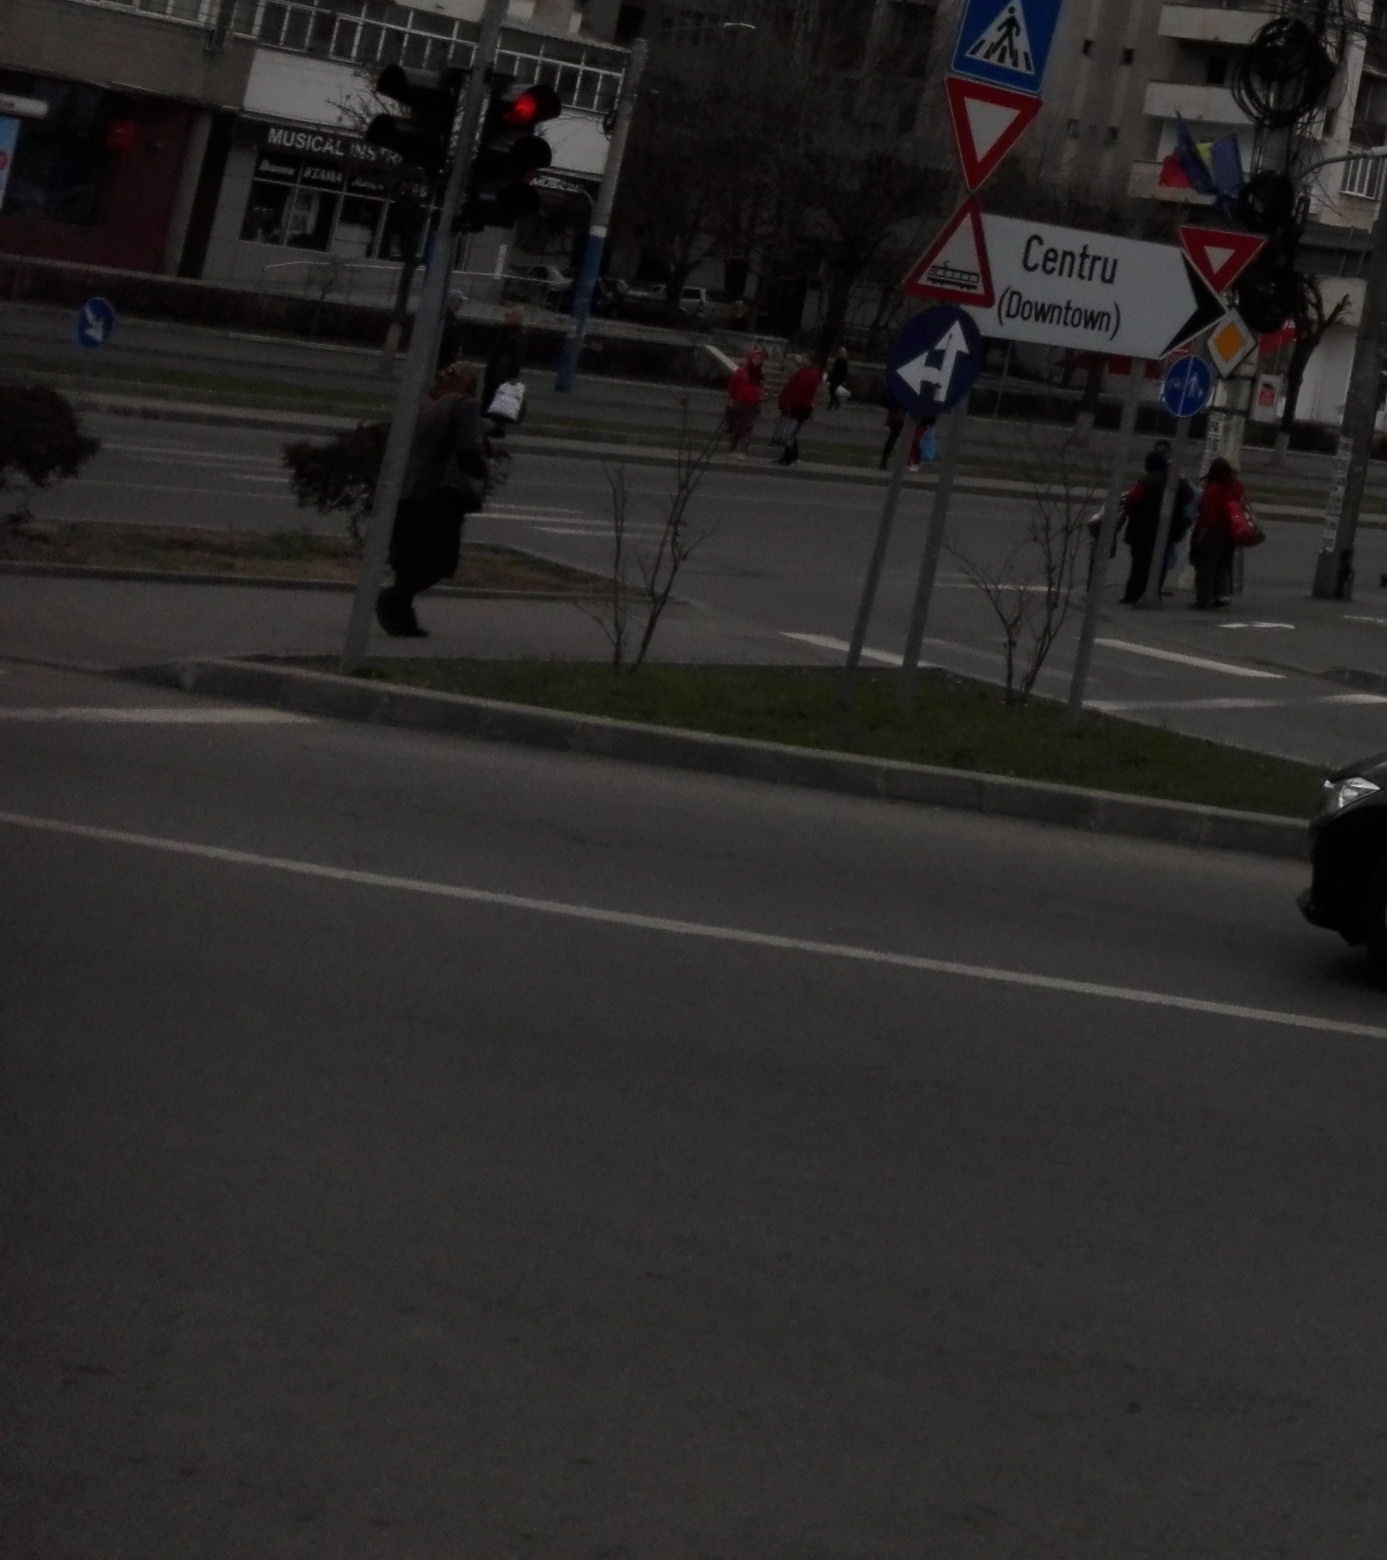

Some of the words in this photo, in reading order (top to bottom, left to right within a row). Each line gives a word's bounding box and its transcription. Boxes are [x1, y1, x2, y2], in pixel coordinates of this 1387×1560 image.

[268, 128, 345, 156] MUSICAL
[1022, 234, 1118, 285] Centru
[997, 287, 1121, 341] (Downtown)
